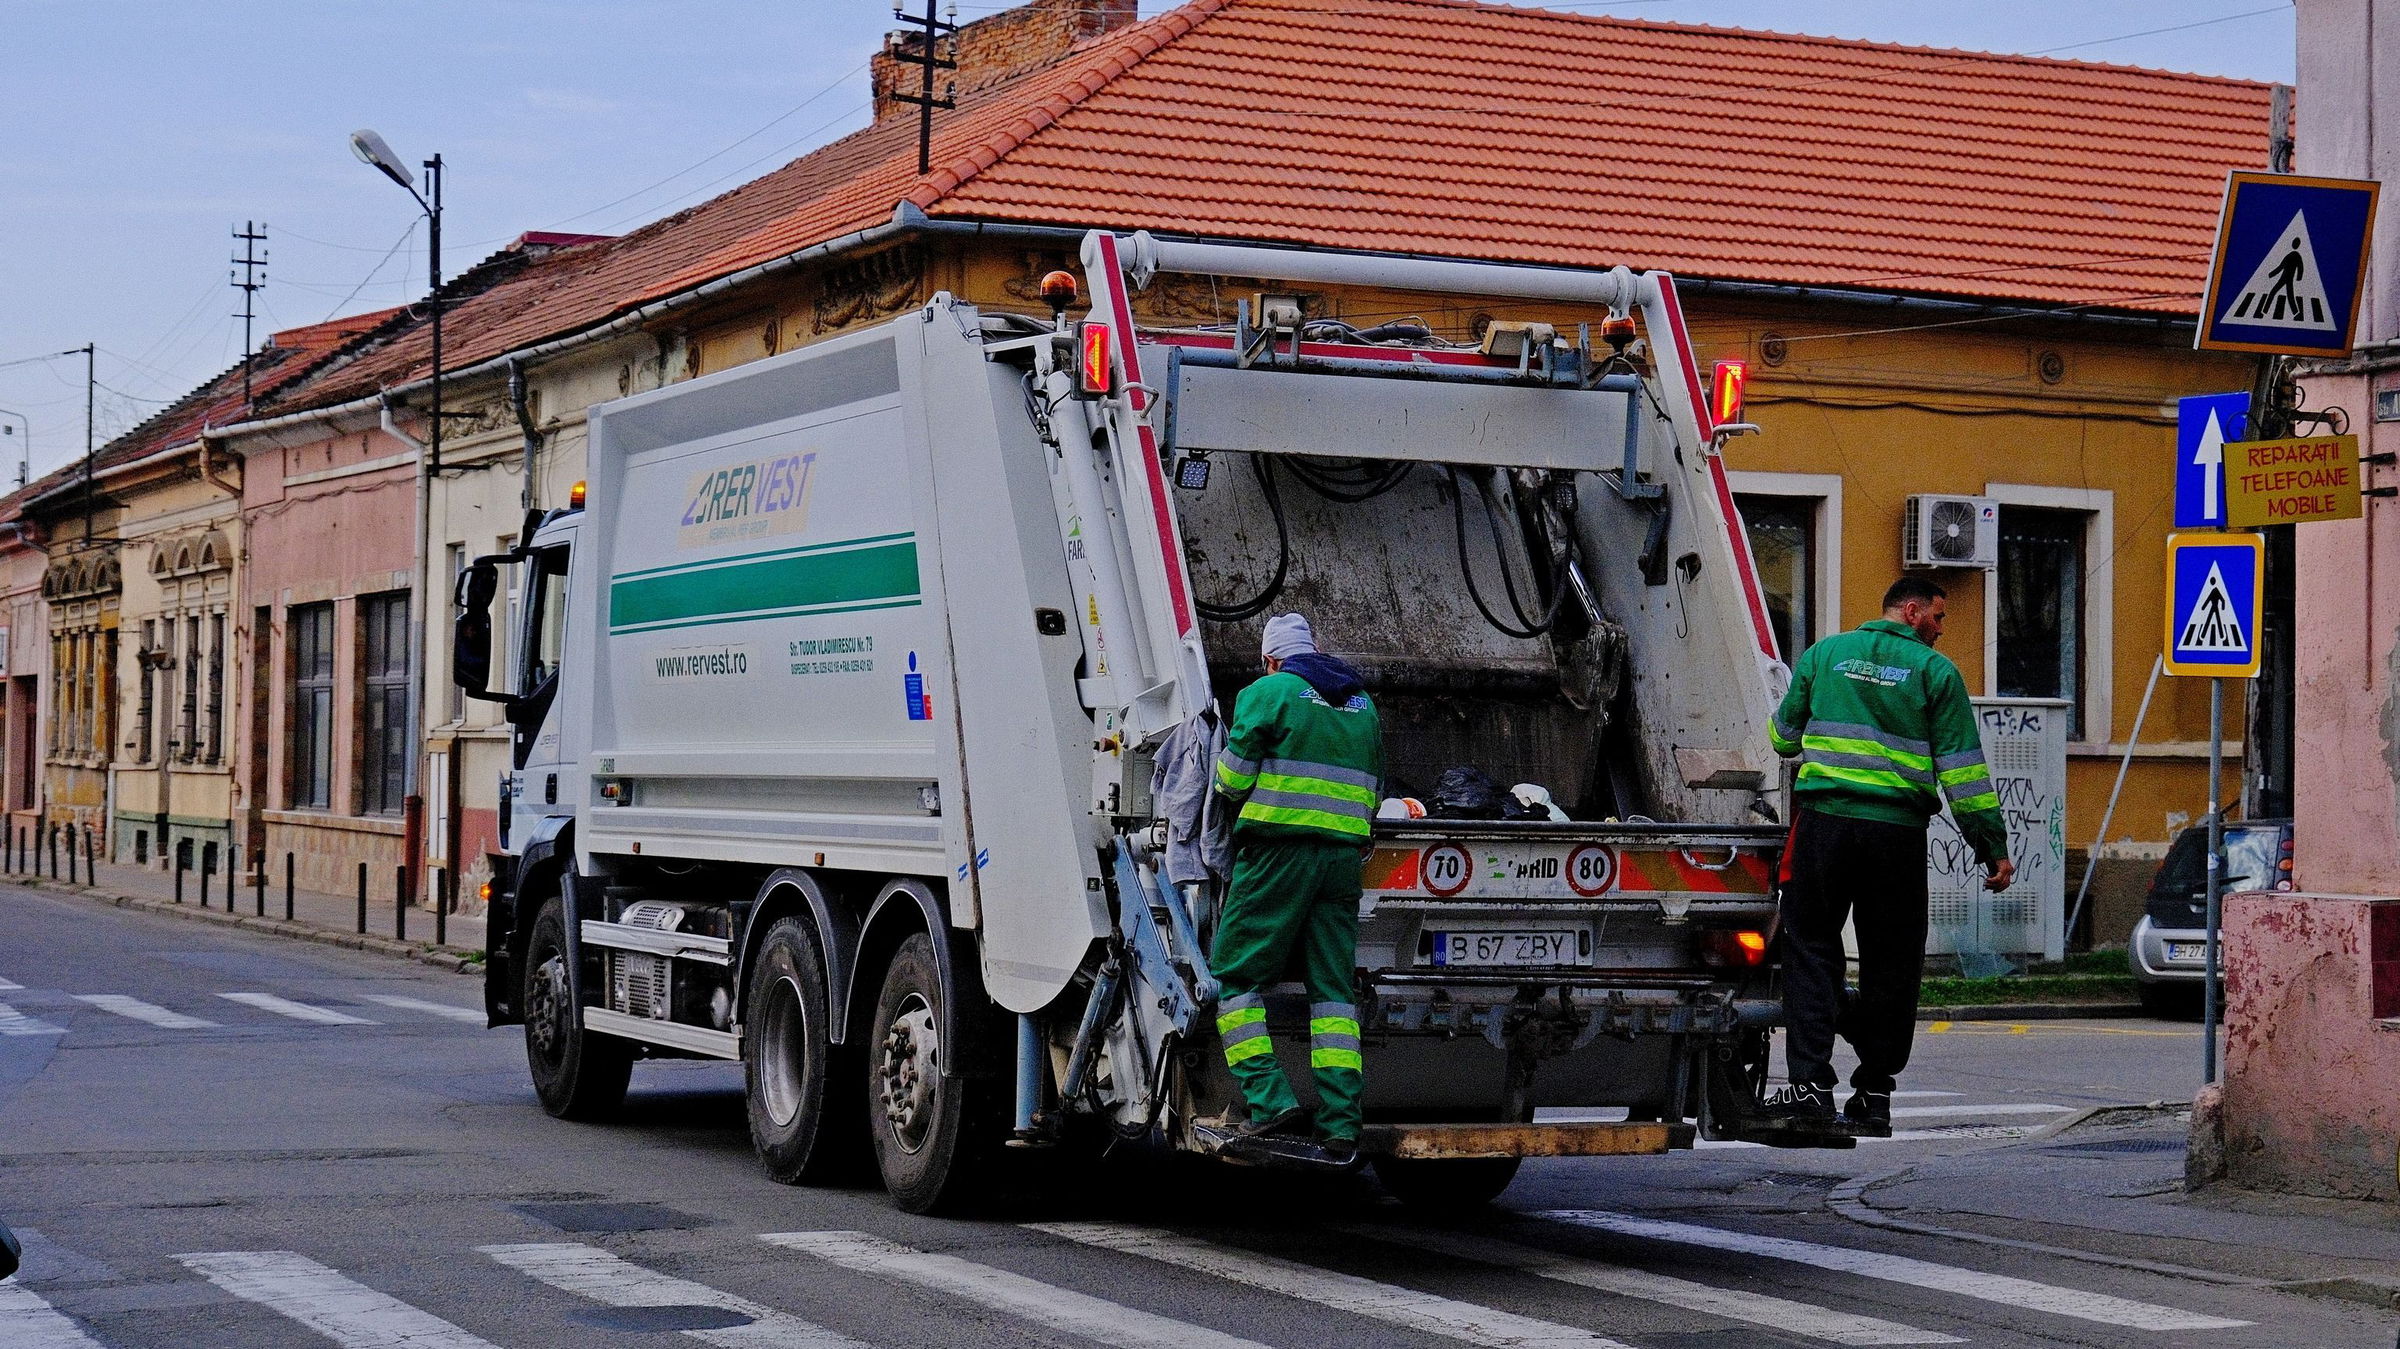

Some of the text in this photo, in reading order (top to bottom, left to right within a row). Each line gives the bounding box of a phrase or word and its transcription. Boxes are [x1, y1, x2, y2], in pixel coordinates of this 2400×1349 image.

[2240, 467, 2349, 494] TELEFOANE
[2268, 494, 2337, 517] MOBILE
[656, 648, 747, 677] www.rervest.ro
[1434, 856, 1459, 879] 70
[1508, 858, 1559, 879] ARID
[1580, 856, 1605, 880] 80
[1435, 951, 1446, 962] RO
[1452, 935, 1564, 961] B 67 ZBY
[2189, 945, 2200, 958] 27
